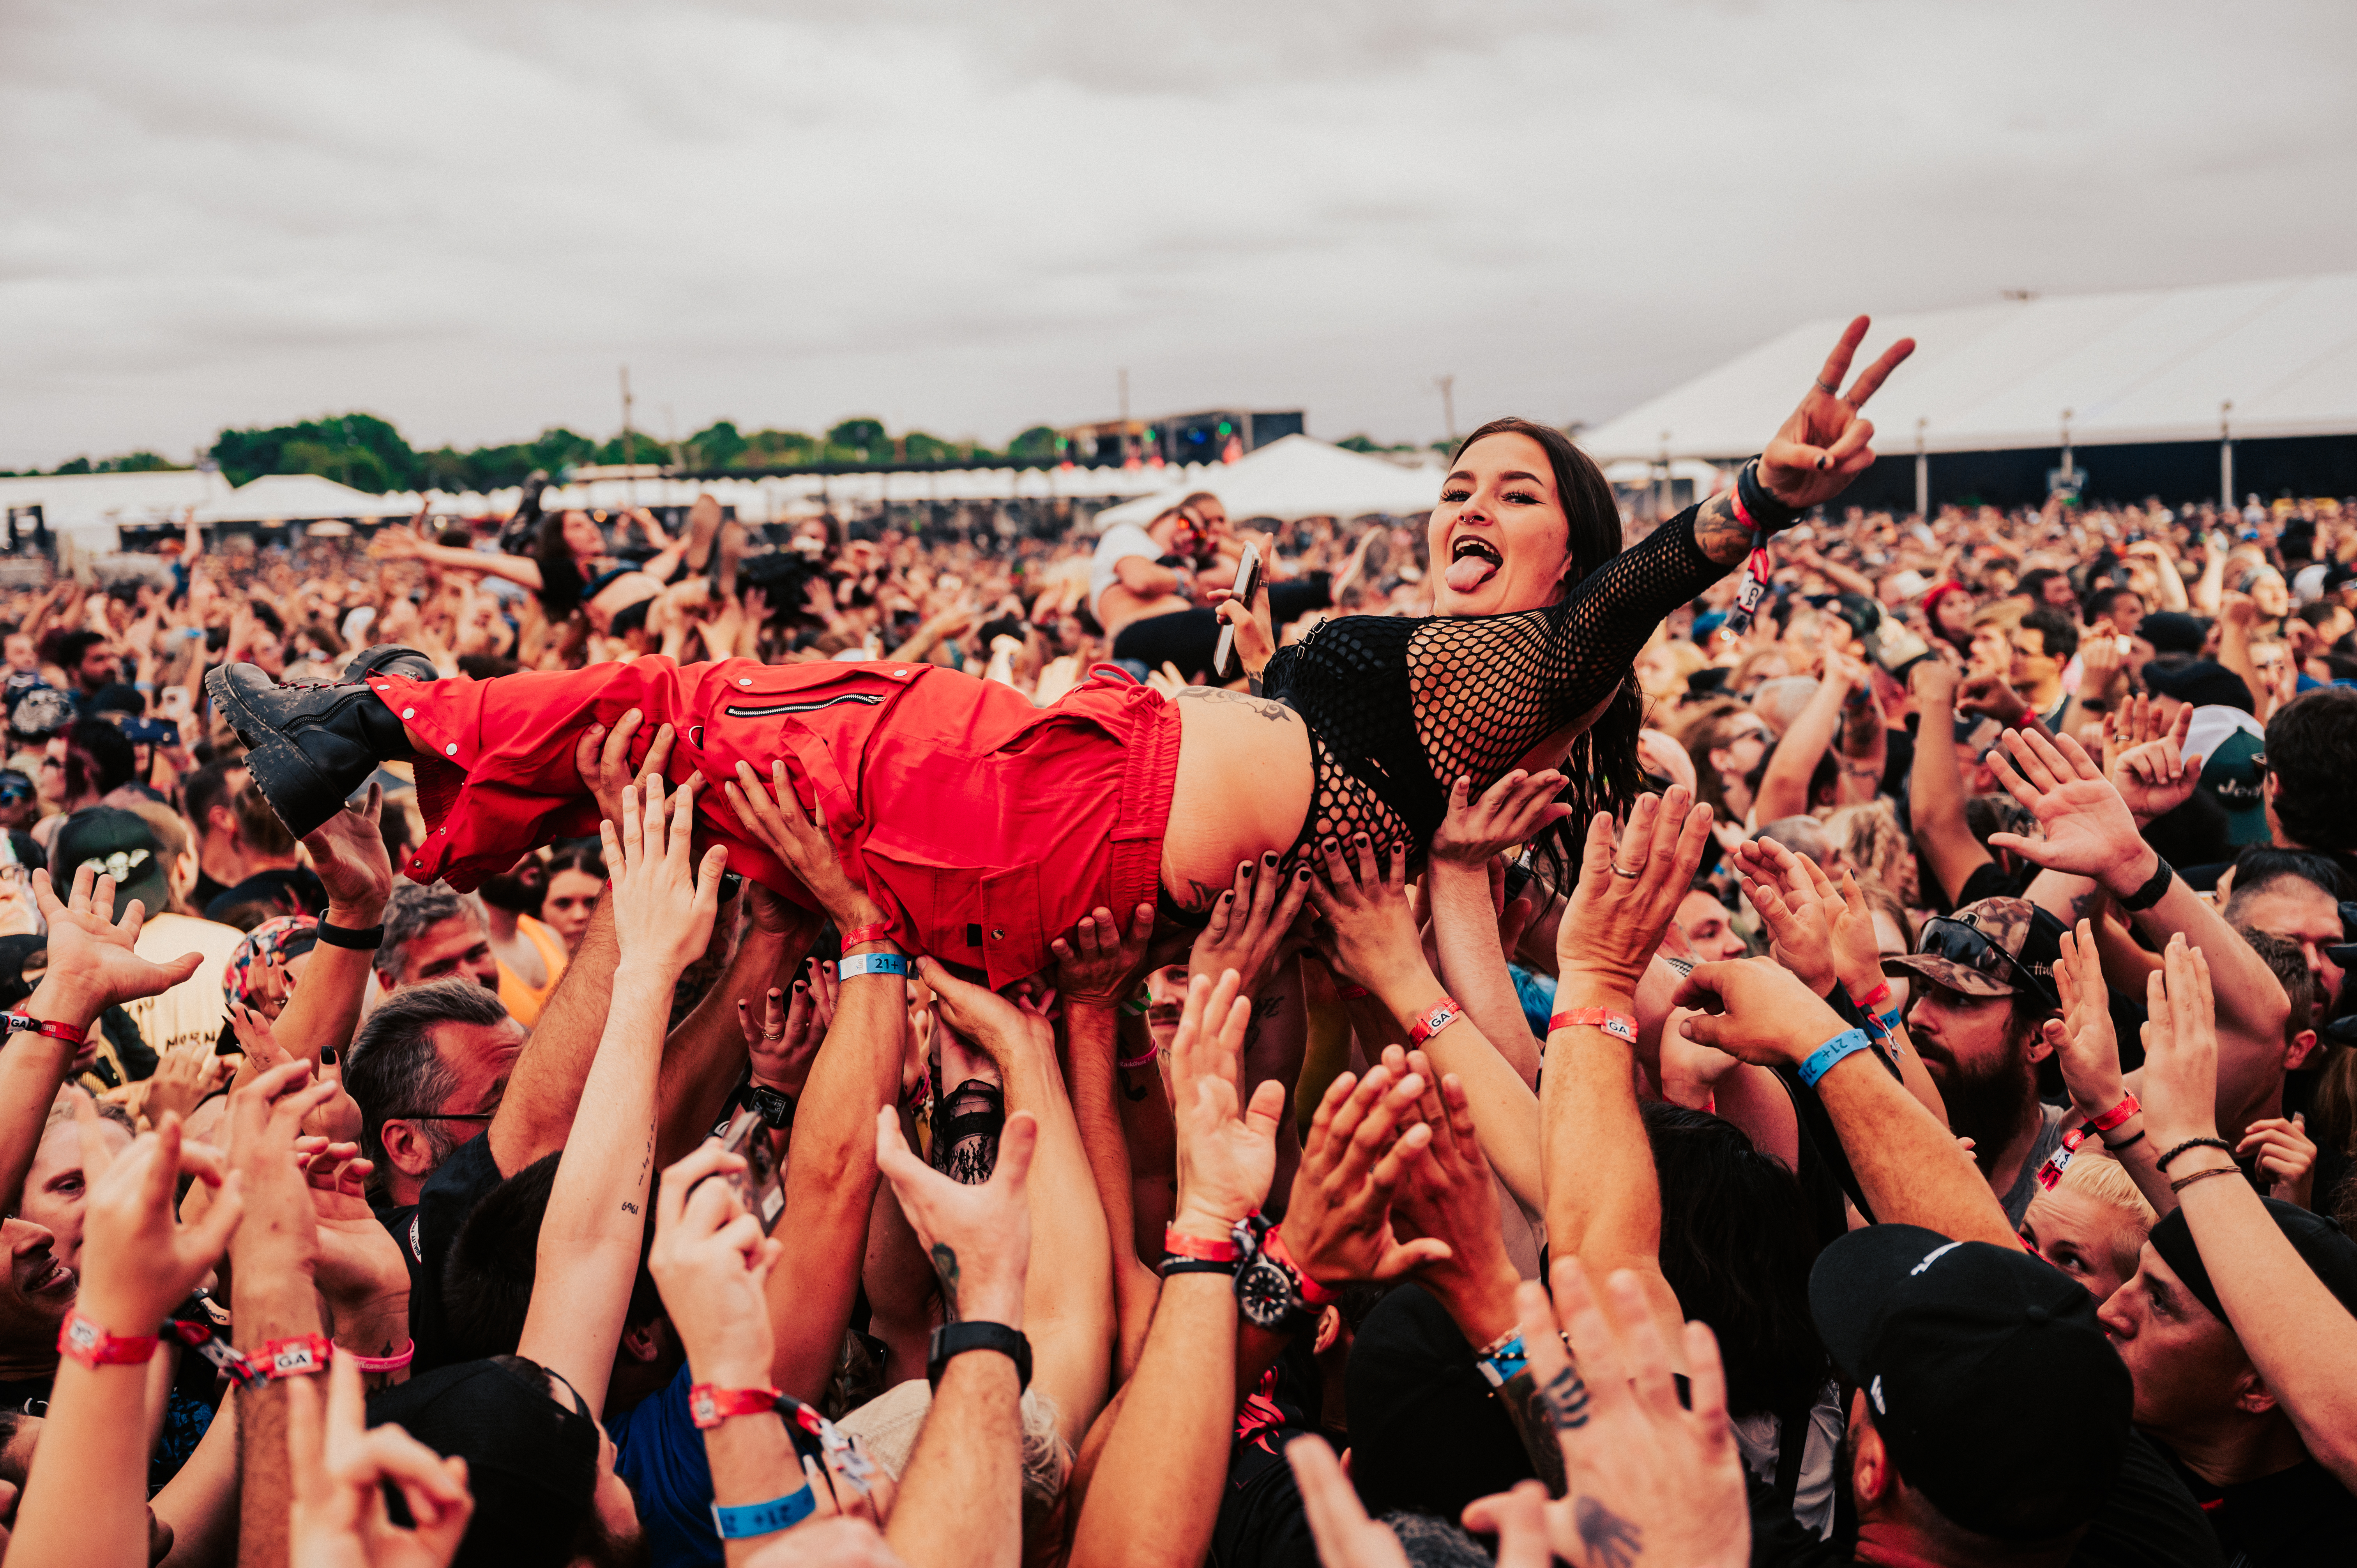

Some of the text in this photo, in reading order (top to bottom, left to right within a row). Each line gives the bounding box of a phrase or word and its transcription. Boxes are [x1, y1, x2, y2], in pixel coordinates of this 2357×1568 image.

[875, 958, 898, 970] 21+
[11, 1019, 26, 1028] GA
[1431, 1013, 1450, 1027] GA
[1609, 1022, 1627, 1035] GA
[1822, 1038, 1848, 1058] 21+
[411, 1236, 421, 1256] QUALITY
[278, 1354, 308, 1368] GA
